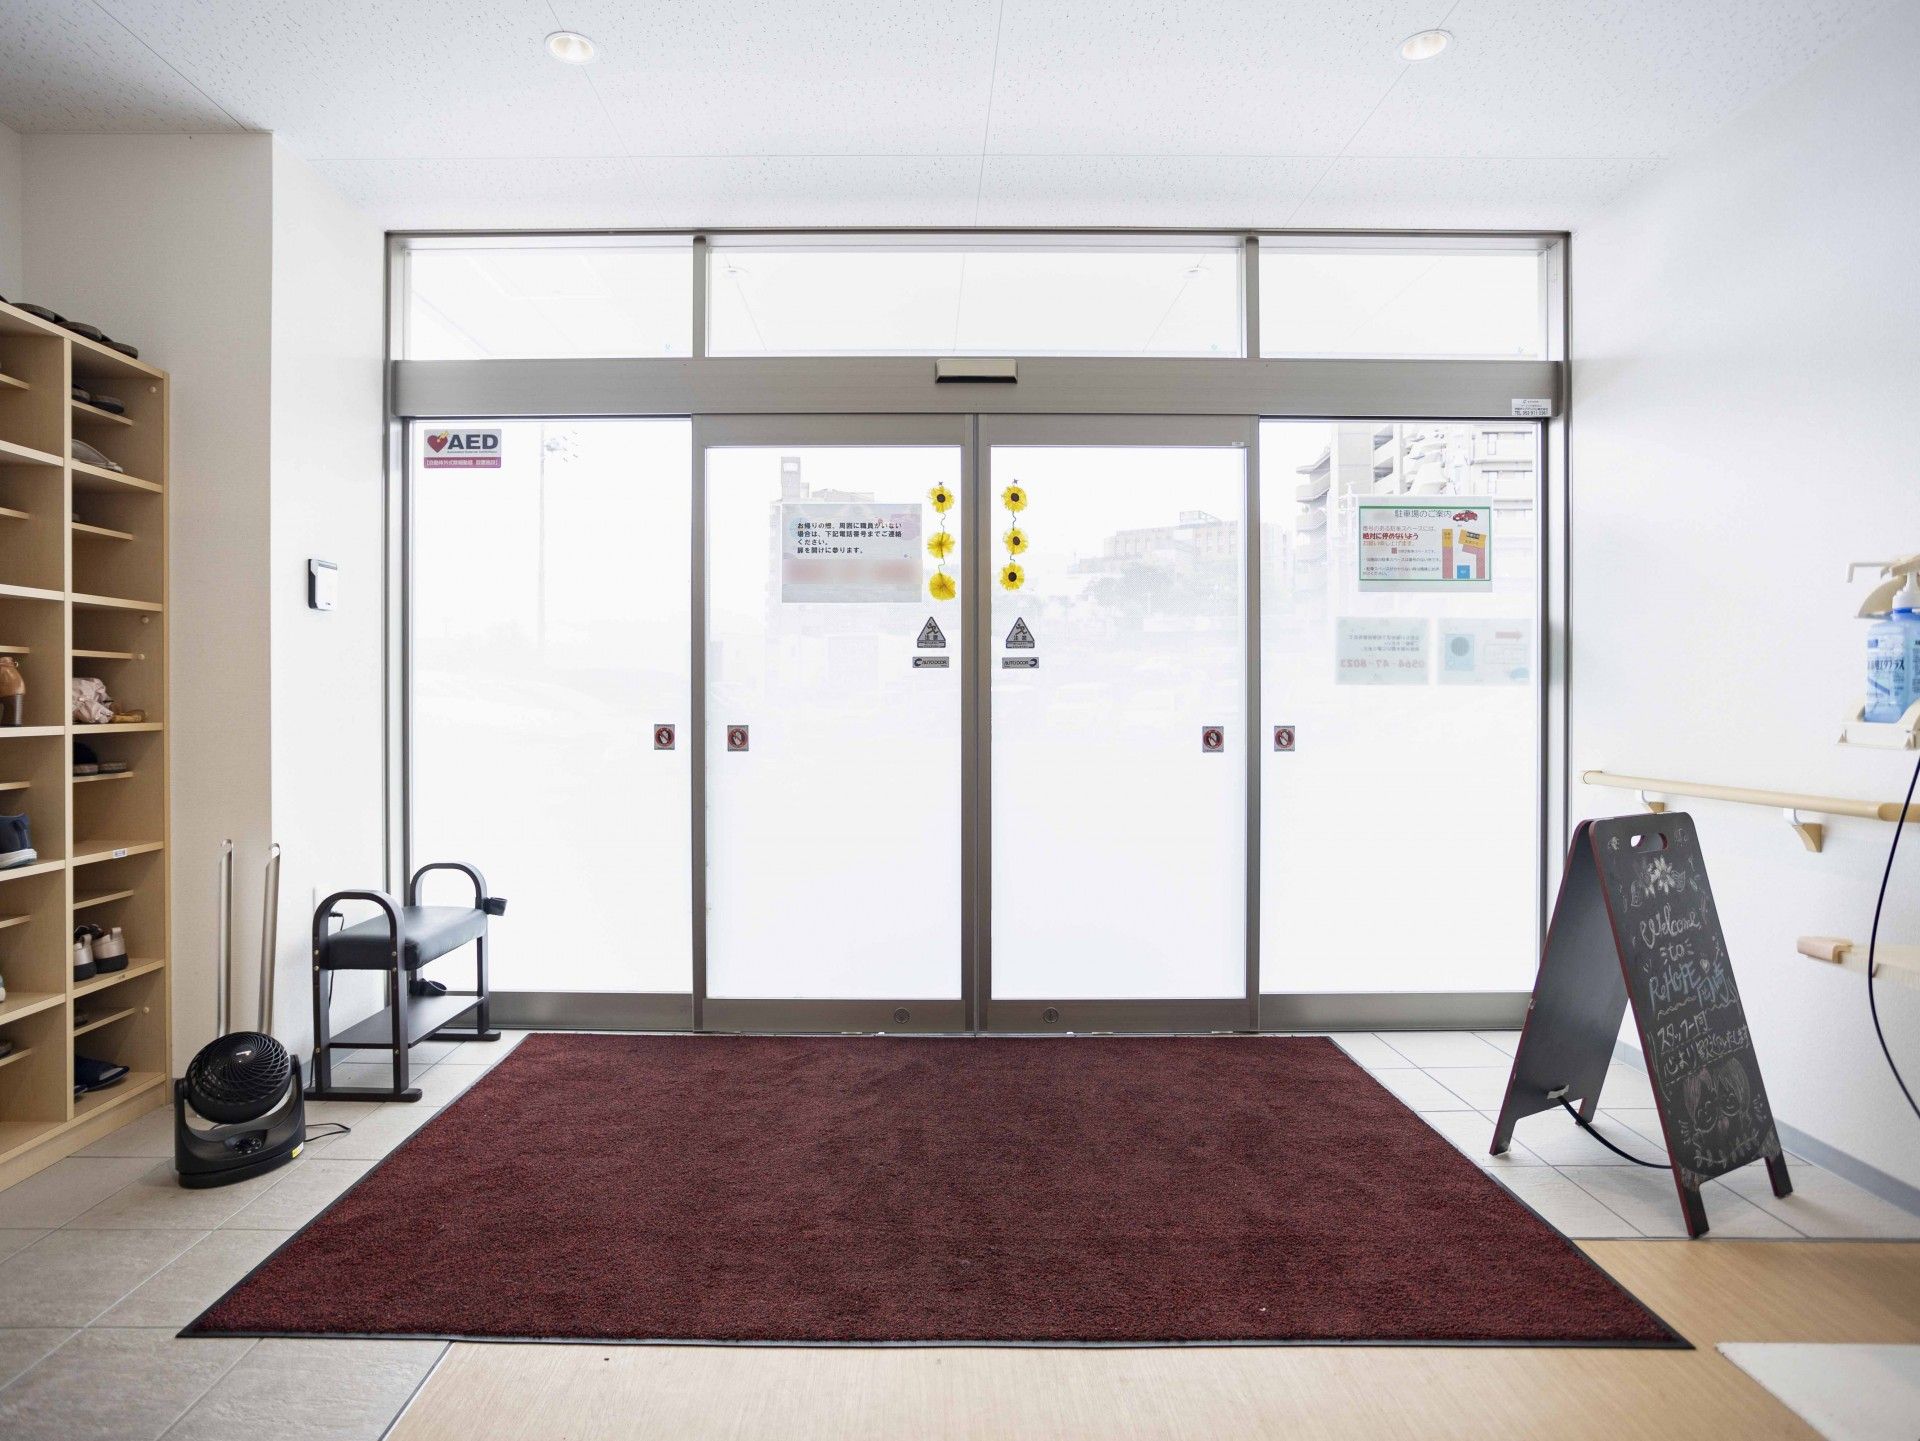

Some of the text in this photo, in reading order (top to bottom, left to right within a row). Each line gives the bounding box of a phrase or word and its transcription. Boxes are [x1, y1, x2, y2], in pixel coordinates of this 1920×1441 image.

[448, 434, 498, 450] AED
[1395, 509, 1452, 519] 駐車場のご案内
[797, 530, 902, 538] 場合は、下記電話番号までご連絡
[1362, 532, 1419, 540] 絶対に停めないよう
[1640, 903, 1700, 948] Welcome
[1668, 943, 1685, 961] to
